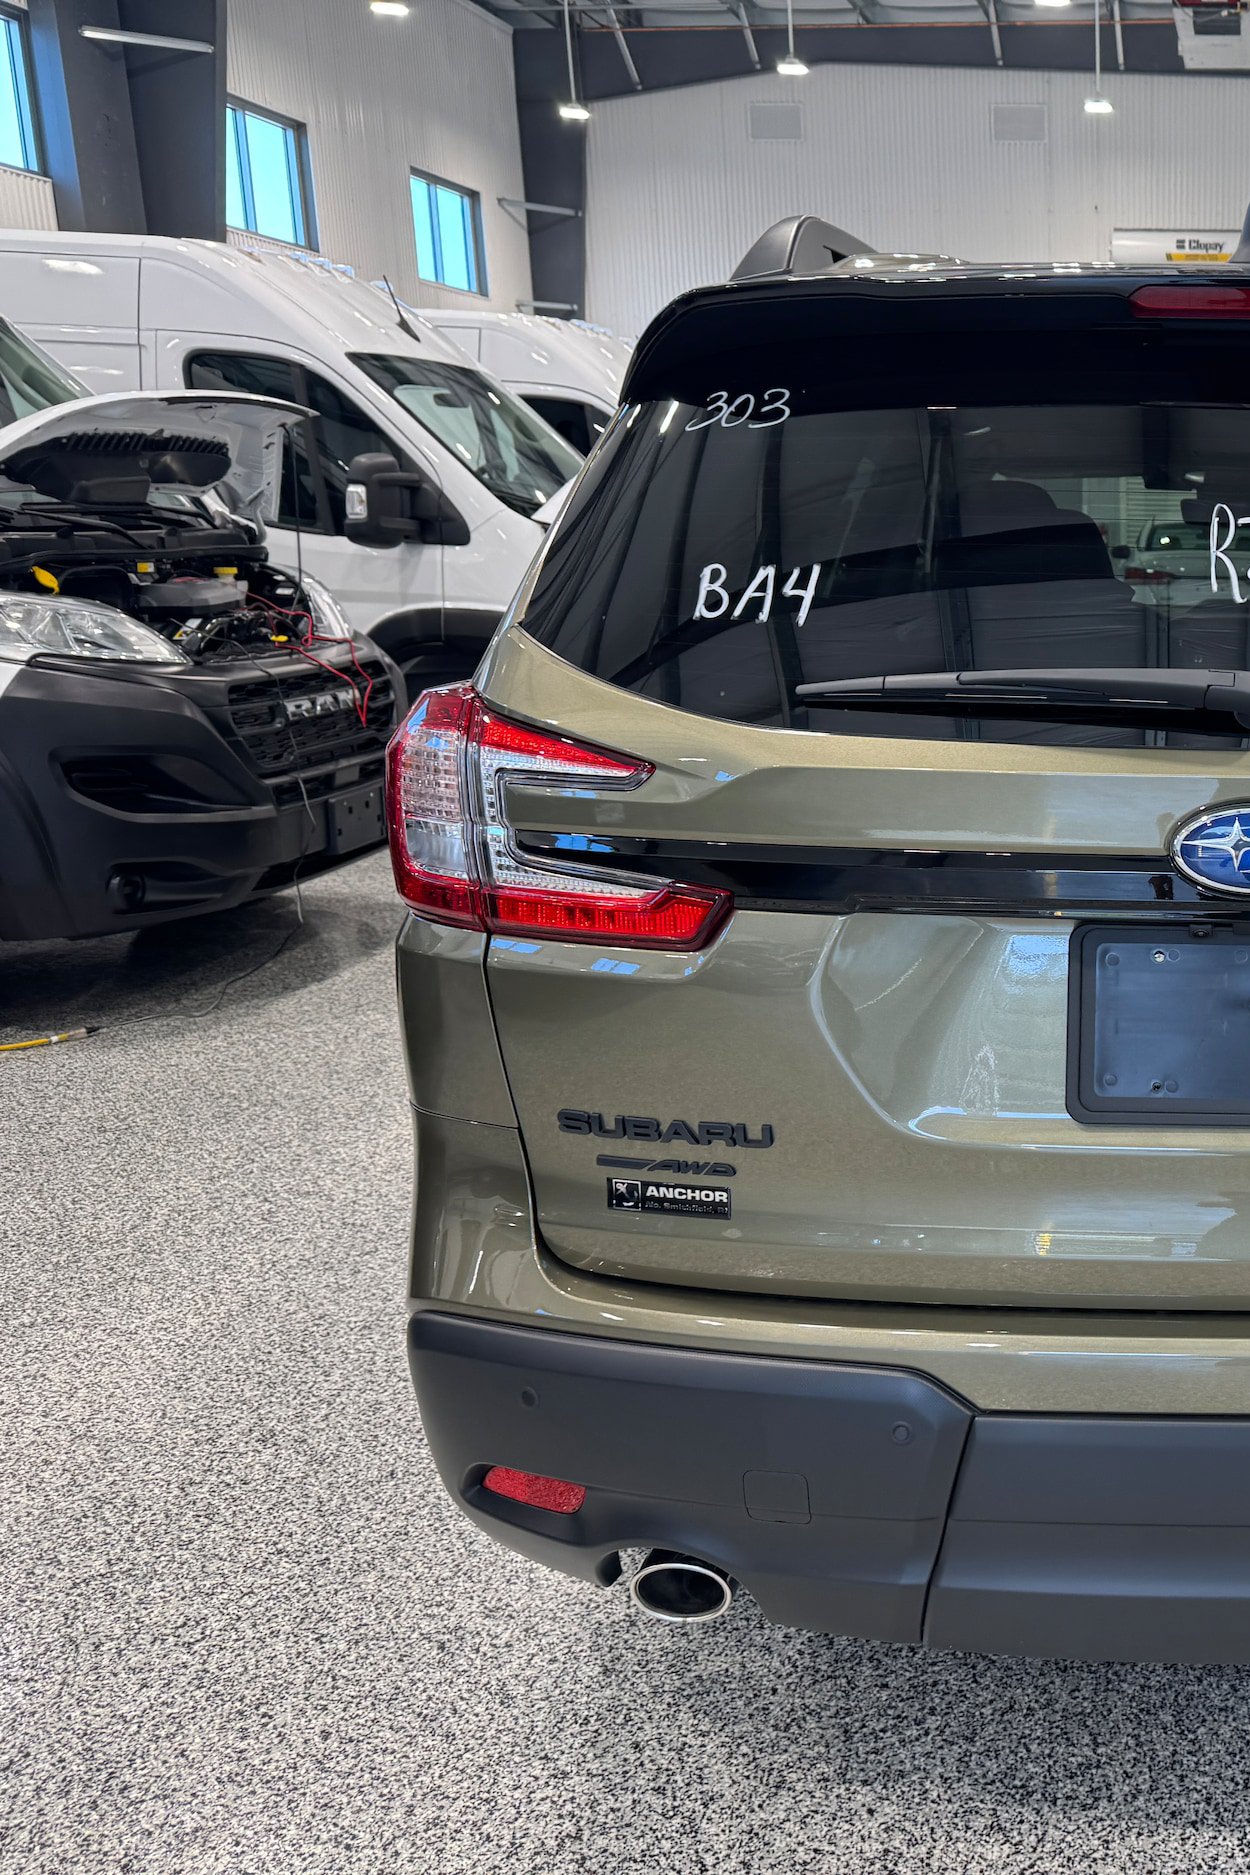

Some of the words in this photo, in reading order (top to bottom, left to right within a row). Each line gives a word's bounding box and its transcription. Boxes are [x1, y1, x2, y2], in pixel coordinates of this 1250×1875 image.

[1188, 239, 1225, 253] Clopay
[685, 388, 791, 432] 303
[693, 563, 822, 628] BA4
[557, 1108, 775, 1149] SUBARU
[646, 1158, 738, 1177] AWD
[645, 1185, 729, 1203] ANCHOR
